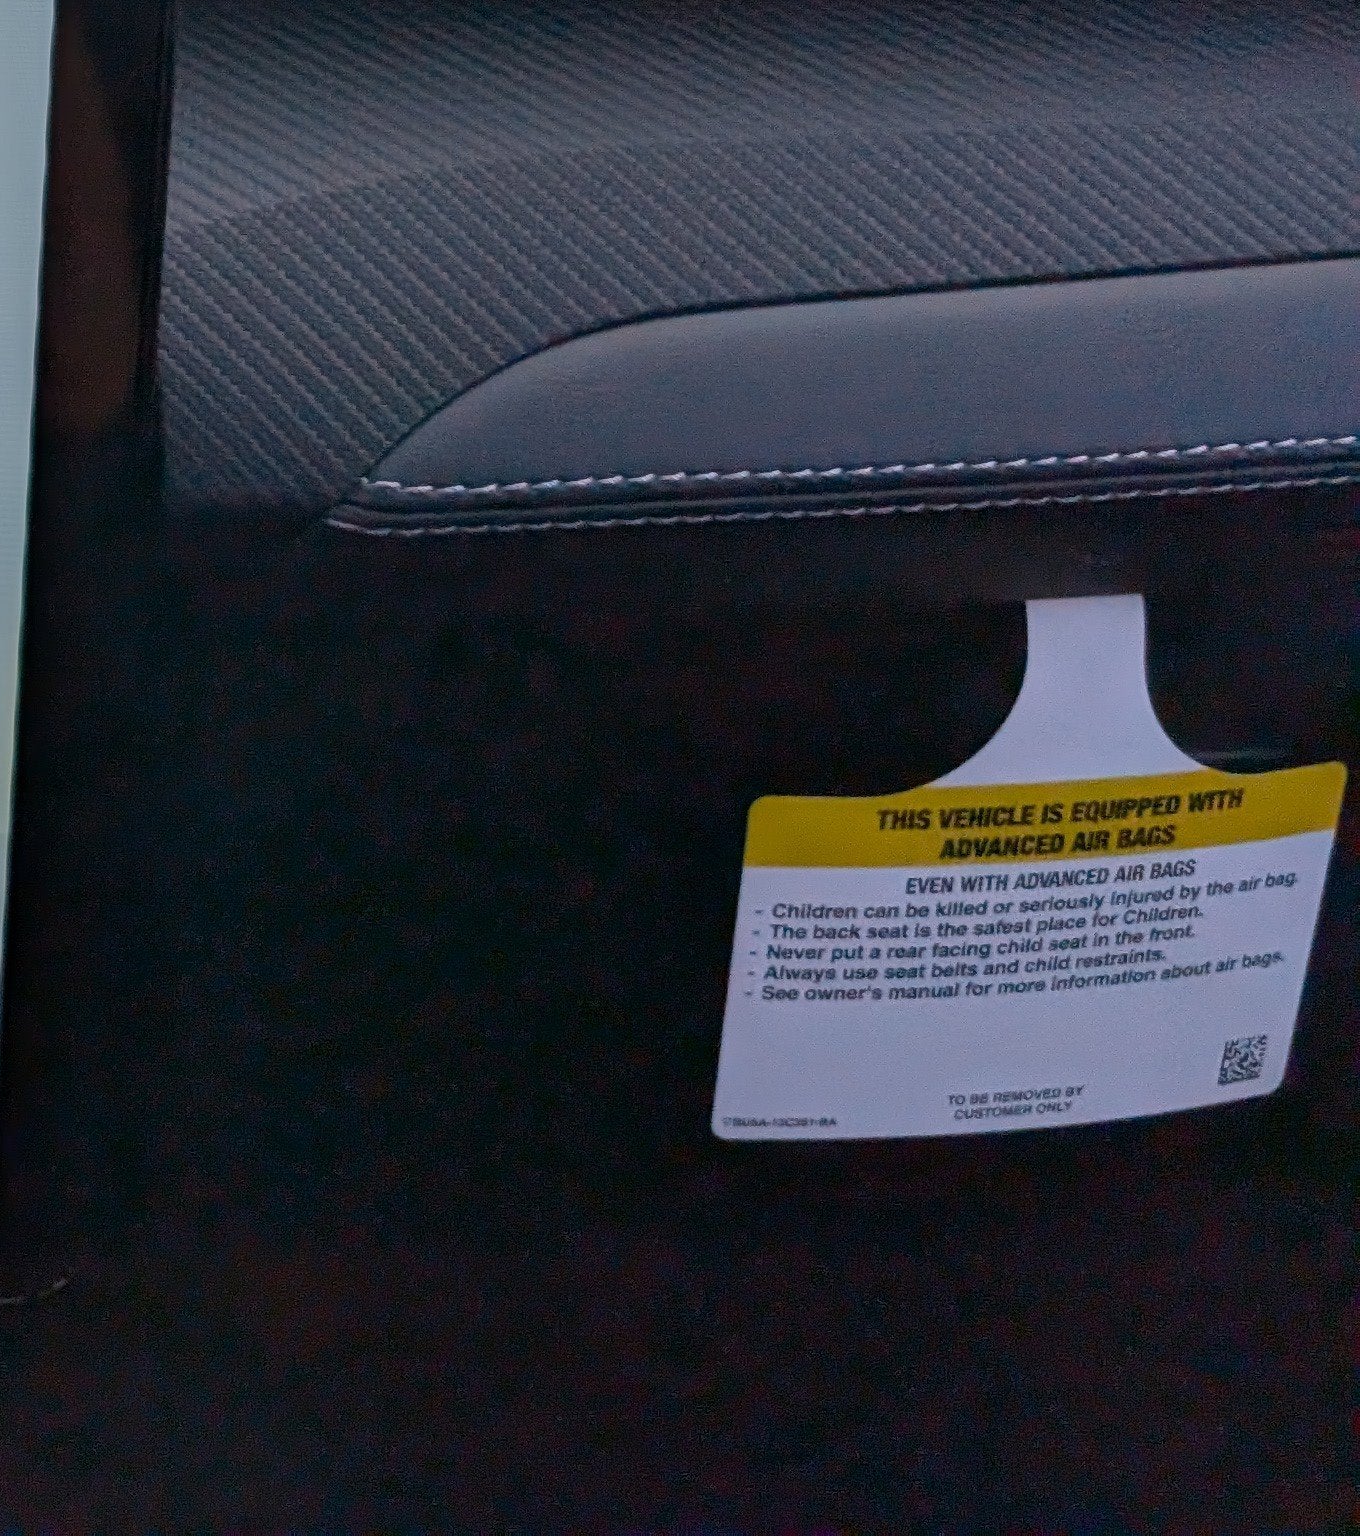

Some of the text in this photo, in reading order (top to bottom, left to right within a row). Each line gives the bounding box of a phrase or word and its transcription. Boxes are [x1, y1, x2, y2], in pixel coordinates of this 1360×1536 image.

[879, 788, 1245, 831] THIS VEHICLE IS EQUIPPED WITH
[940, 825, 1176, 859] ADVANCED AIR BAGS
[906, 859, 1197, 895] EVEN WITH ADVANCED AIR BAGS
[771, 902, 858, 920] Children
[863, 905, 900, 919] can
[905, 903, 930, 918] be
[935, 900, 988, 916] killed
[993, 902, 1014, 915] or
[1019, 894, 1104, 914] seriously
[1180, 884, 1201, 902] by
[1206, 880, 1233, 895] the
[1238, 876, 1263, 892] air
[769, 923, 807, 939] The
[813, 923, 860, 939] back
[866, 924, 907, 938] seat
[937, 921, 967, 936] the
[972, 915, 1030, 934] safest
[1036, 917, 1086, 935] place
[1092, 912, 1117, 928] for
[1123, 904, 1203, 925] Children.
[766, 944, 825, 960] Never
[831, 945, 864, 962] put
[869, 948, 880, 959] a
[886, 945, 926, 959] rear
[932, 941, 991, 959] facing
[996, 938, 1042, 955] child
[1048, 935, 1087, 952] seat
[1115, 929, 1143, 945] the
[762, 986, 799, 1001] See
[804, 985, 881, 1001] owner's
[888, 983, 959, 1000] manual
[965, 981, 991, 996] for
[997, 979, 1045, 994] more
[1050, 970, 1157, 991] information
[1160, 961, 1210, 980] about
[1215, 956, 1237, 973] air
[763, 966, 835, 982] Always
[843, 967, 878, 980] use
[883, 964, 926, 979] seat
[931, 962, 977, 978] belts
[983, 960, 1019, 975] and
[1024, 955, 1070, 973] child
